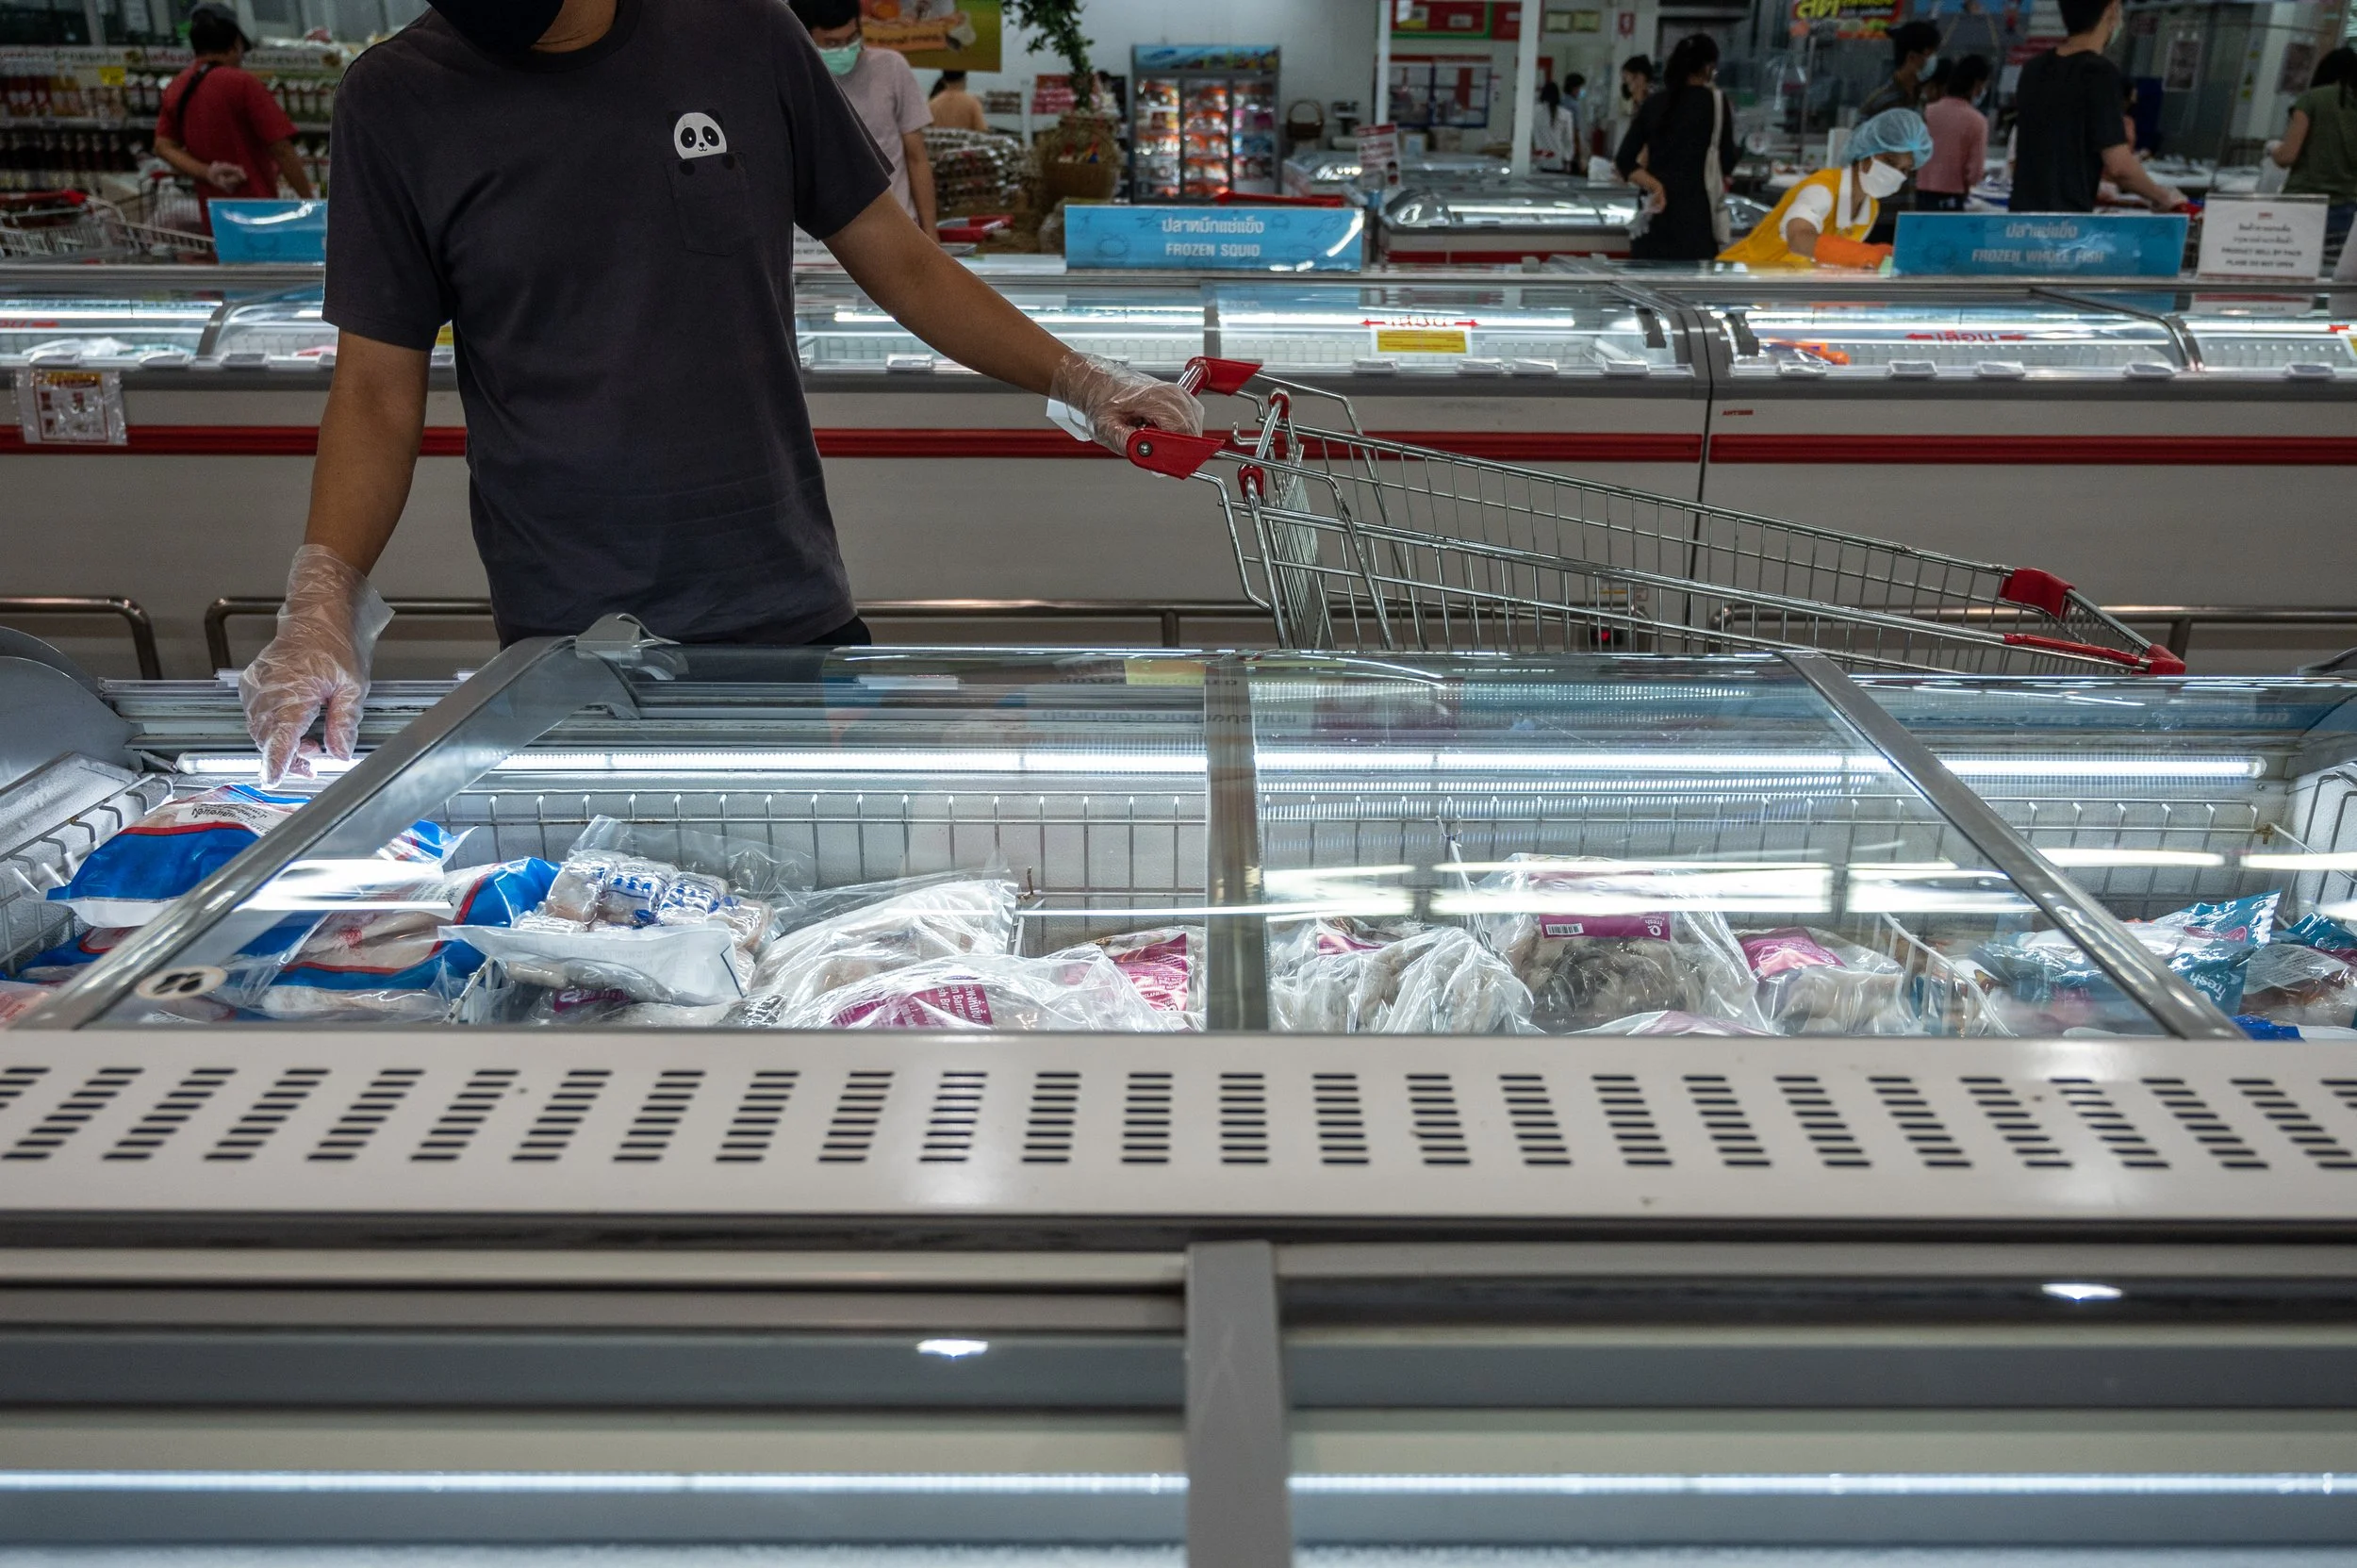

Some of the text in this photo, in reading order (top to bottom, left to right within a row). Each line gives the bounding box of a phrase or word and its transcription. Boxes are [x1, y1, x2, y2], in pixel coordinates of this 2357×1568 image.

[1162, 216, 1265, 234] ปลาหมึกแช่แข็ง
[1165, 243, 1261, 257] FROZEN SQUID
[1972, 249, 2021, 263] FROZEN
[2025, 249, 2071, 264] WHOLE
